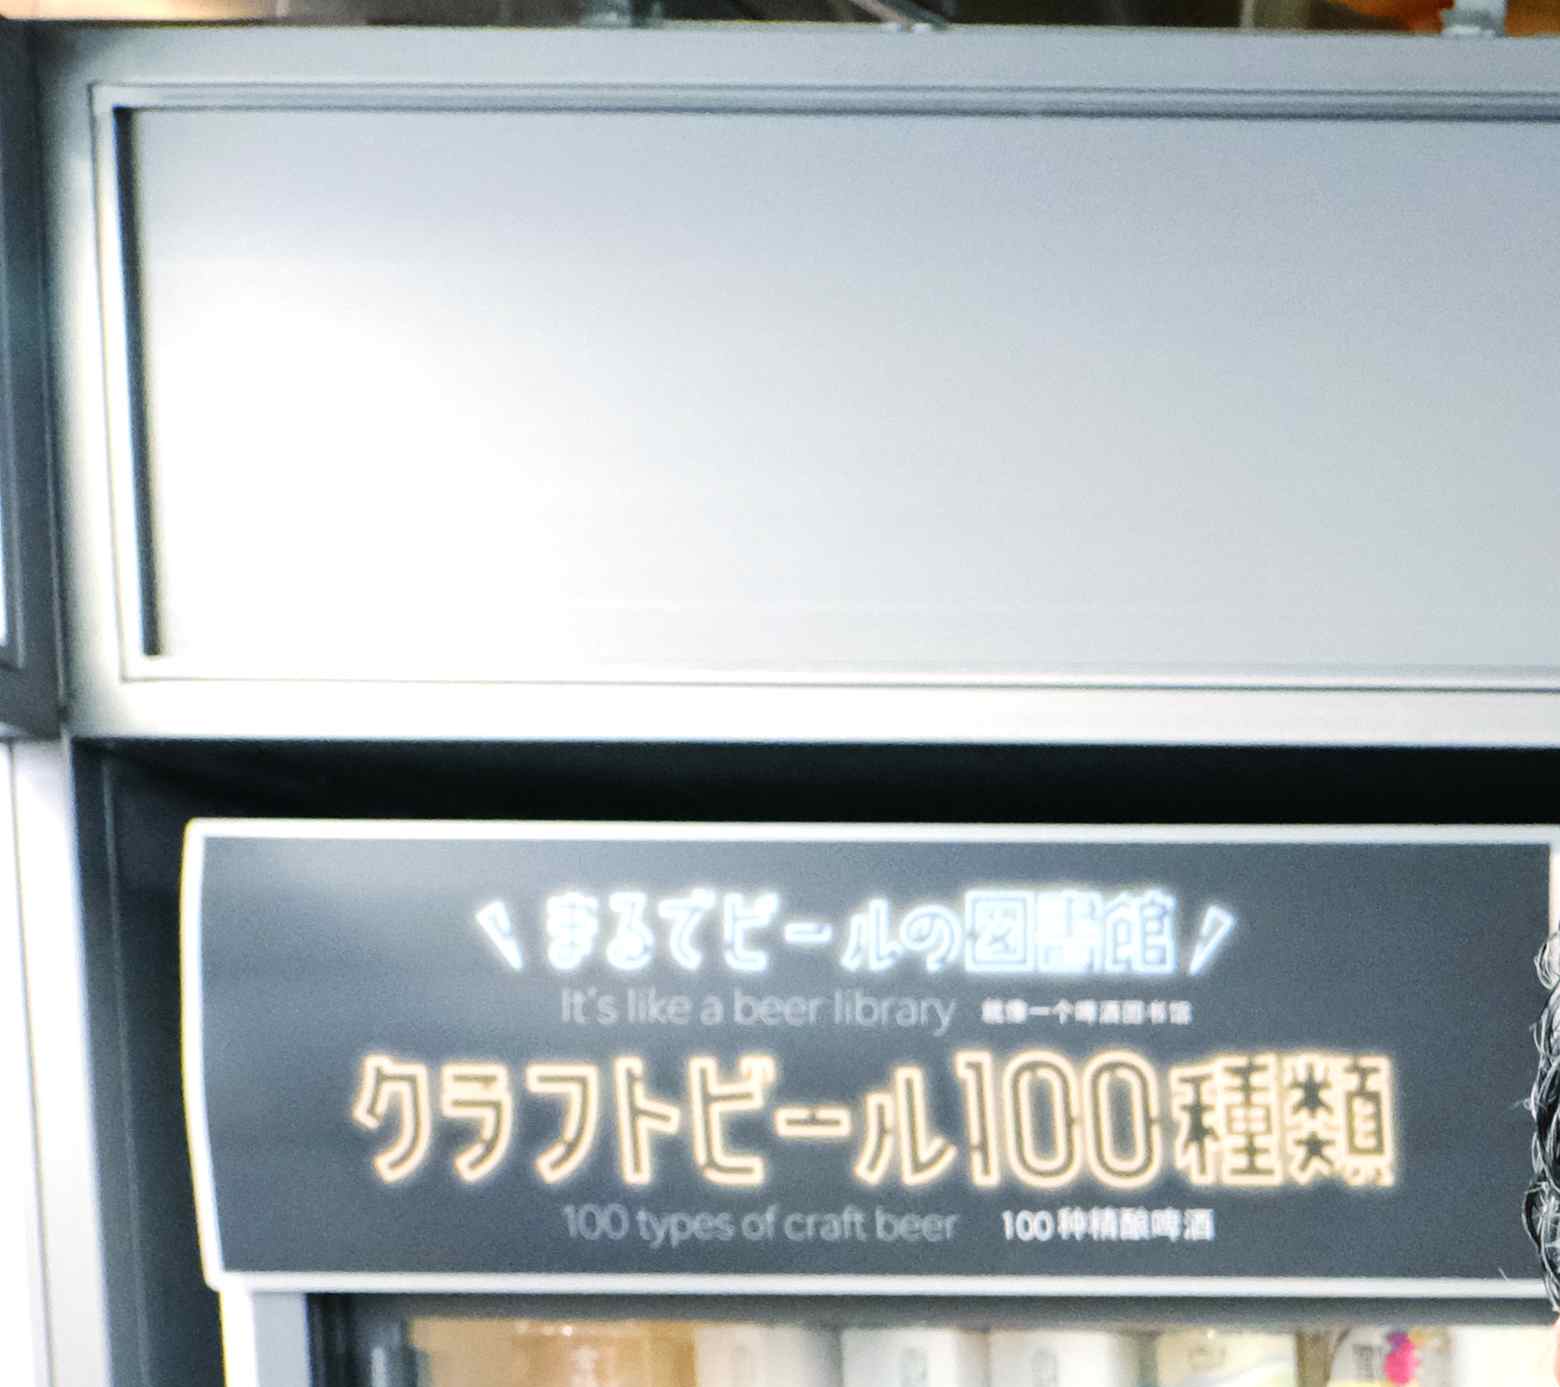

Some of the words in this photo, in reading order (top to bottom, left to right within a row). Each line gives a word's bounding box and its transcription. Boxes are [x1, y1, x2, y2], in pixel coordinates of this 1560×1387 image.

[545, 887, 1177, 975] まるでビールの図書館
[561, 987, 617, 1025] It's
[628, 987, 691, 1025] like
[699, 996, 724, 1026] a
[734, 988, 824, 1026] beer
[834, 988, 957, 1036] library
[351, 1050, 1396, 1190] クラフトビール100種類
[562, 1204, 630, 1239] 100
[636, 1207, 735, 1248] types
[742, 1203, 778, 1240] of
[783, 1203, 867, 1240] craft
[875, 1204, 960, 1240] beer
